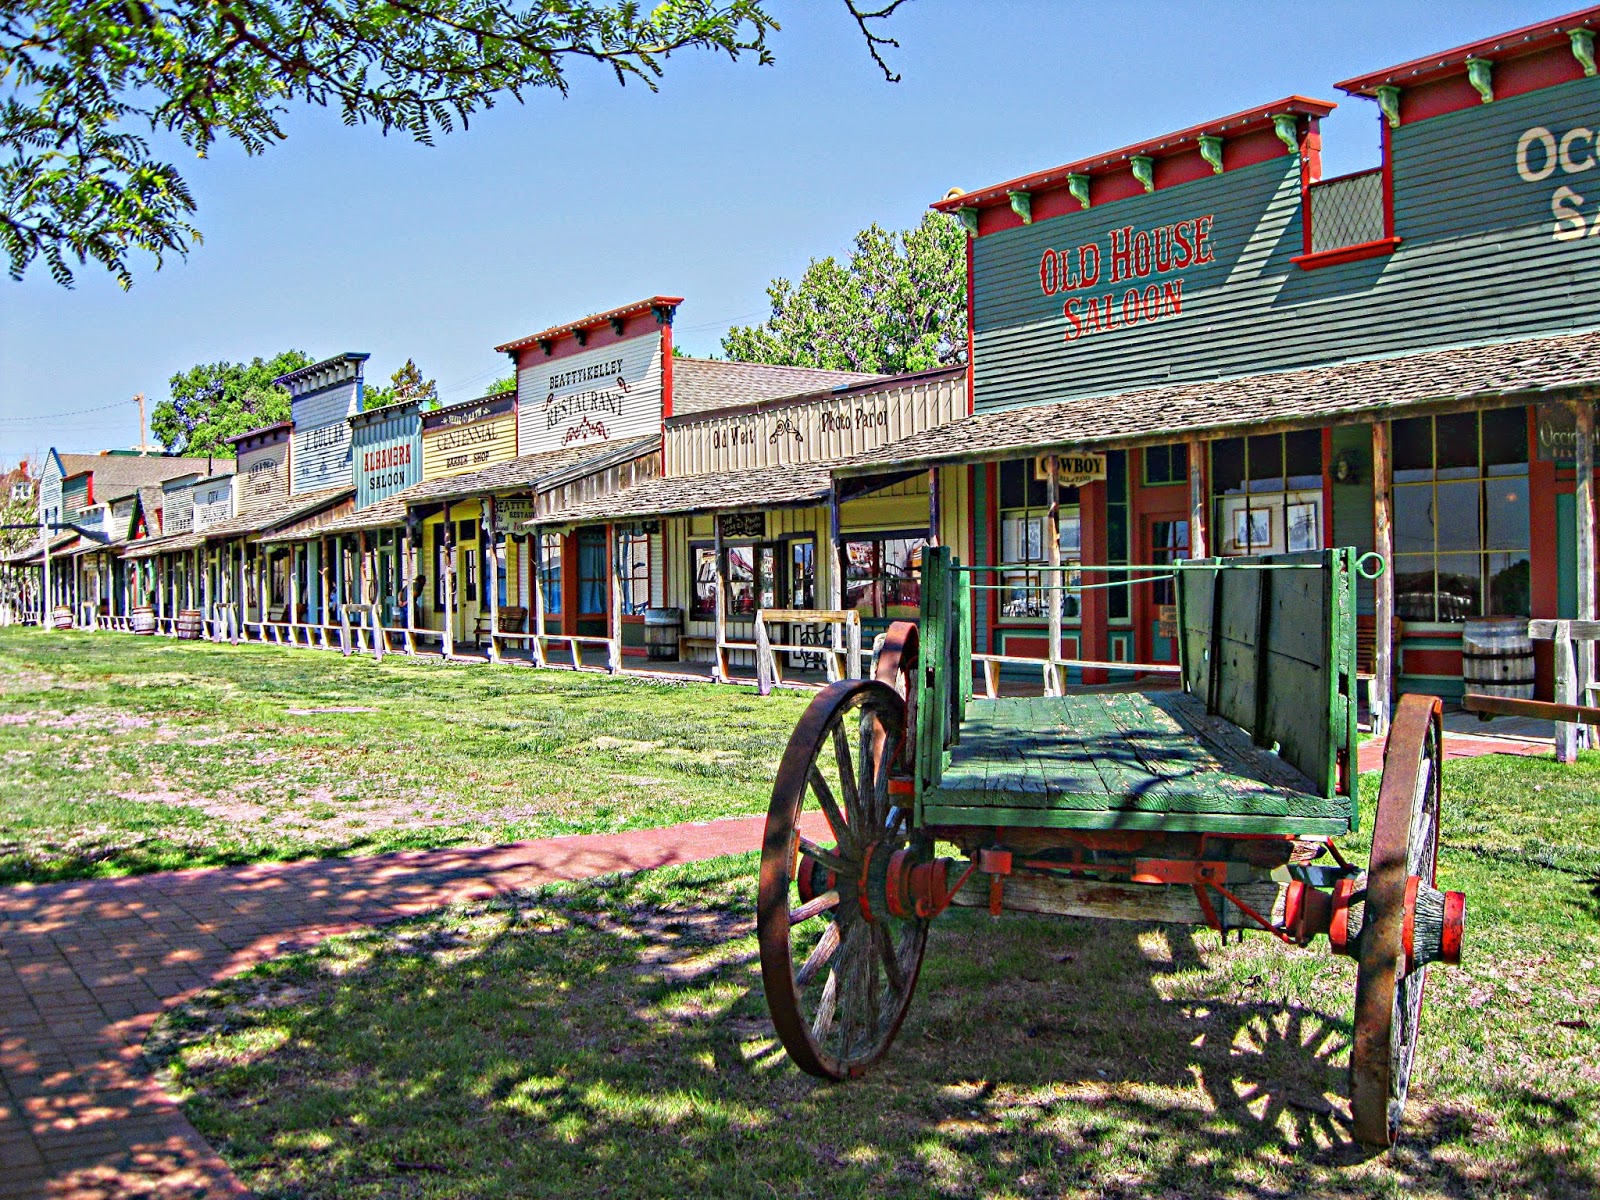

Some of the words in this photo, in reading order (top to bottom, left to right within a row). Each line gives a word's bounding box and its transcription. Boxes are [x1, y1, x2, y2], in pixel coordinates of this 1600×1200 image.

[1515, 126, 1600, 183] OC
[1039, 243, 1101, 297] OLD
[1108, 214, 1216, 284] HOUSE
[1063, 279, 1184, 343] SALOON
[547, 391, 625, 430] RESTAURANT
[821, 411, 851, 433] Photo
[855, 408, 888, 430] Paror
[364, 443, 411, 472] ALHAMBRA
[474, 451, 490, 463] SHOP
[1041, 457, 1102, 473] CWBOY
[370, 471, 405, 490] SALOON
